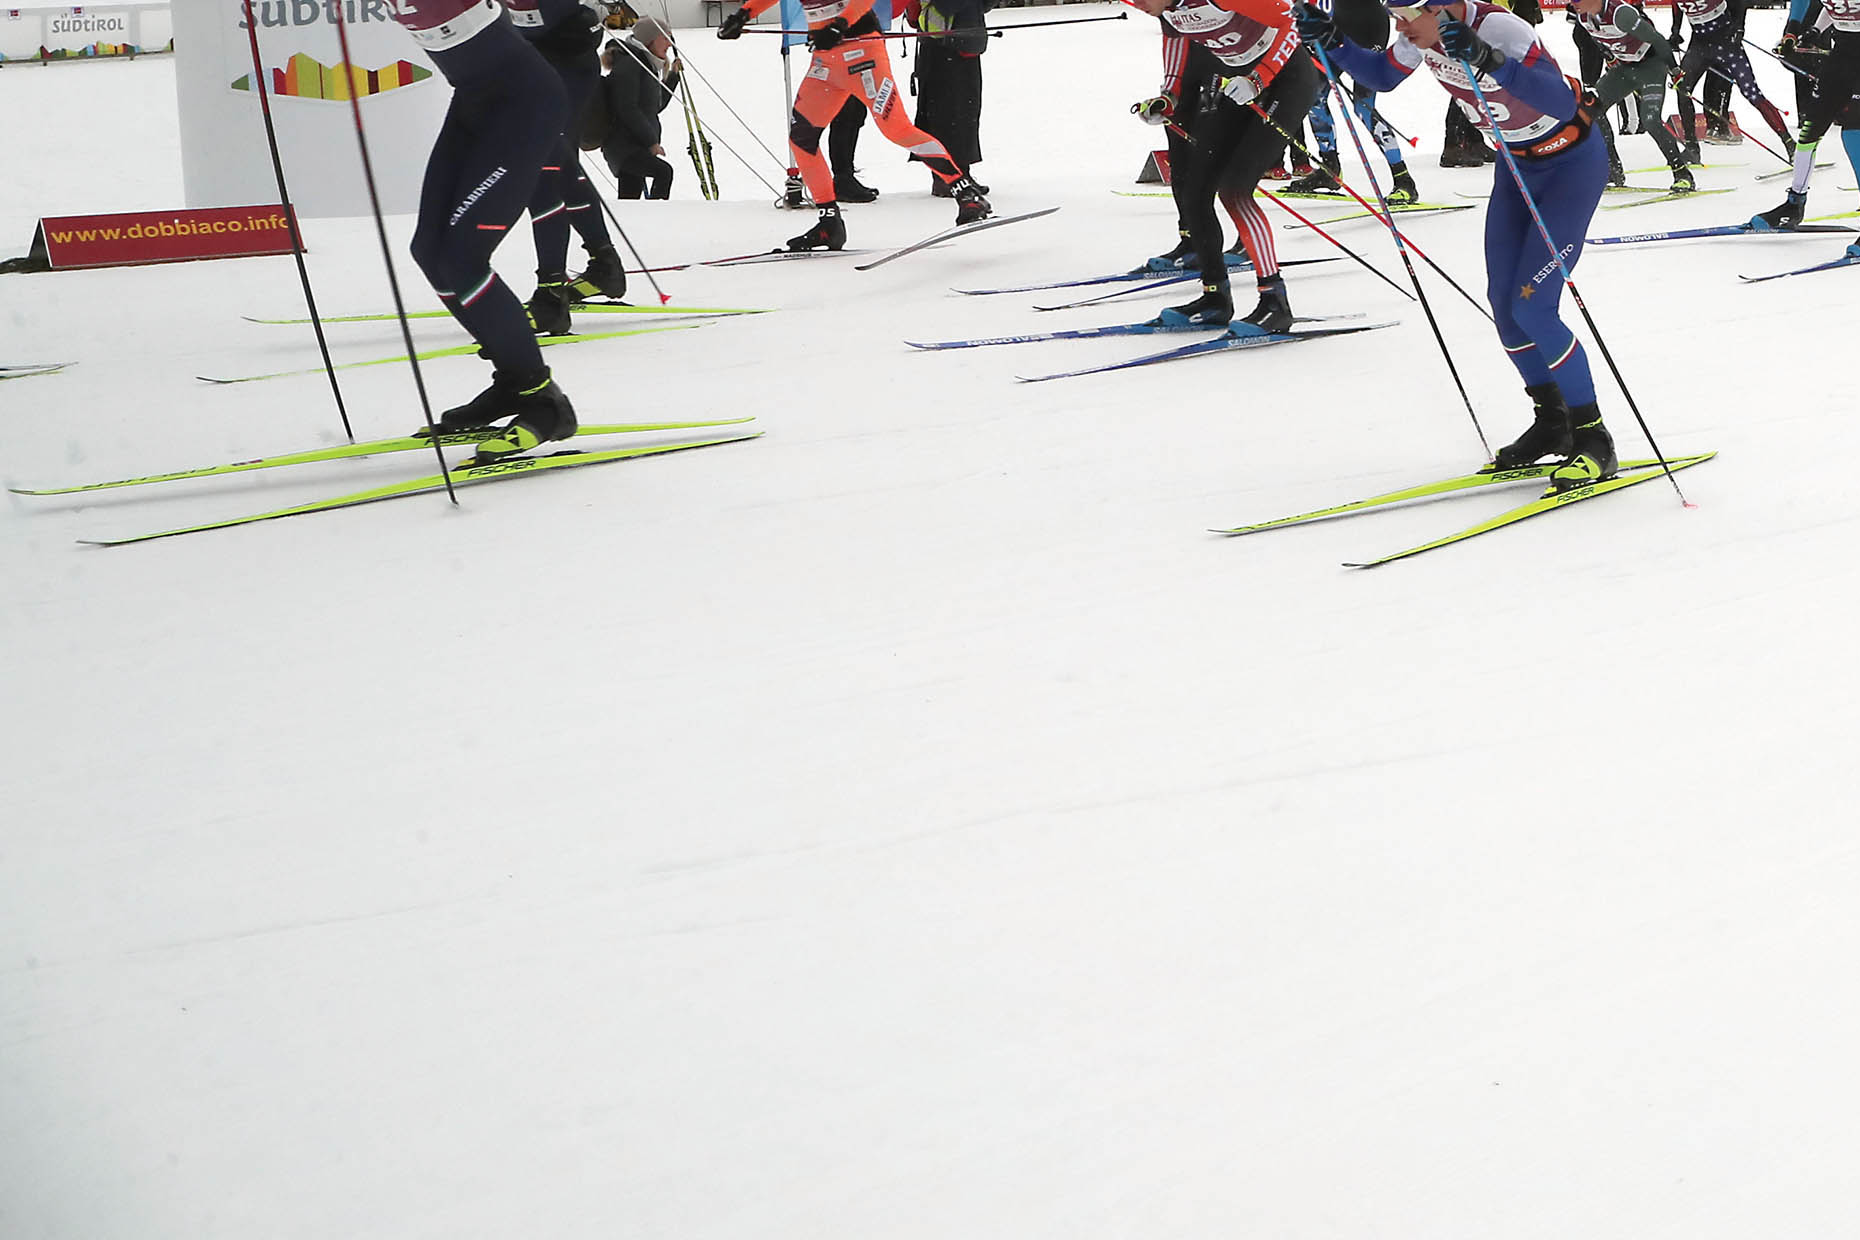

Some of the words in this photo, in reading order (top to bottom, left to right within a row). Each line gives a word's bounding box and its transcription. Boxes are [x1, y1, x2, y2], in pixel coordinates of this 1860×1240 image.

[450, 166, 508, 226] CARABINIERI
[51, 214, 289, 244] www.dobbiaco.info
[1227, 335, 1271, 348] SALOMON
[466, 460, 537, 478] FISCHER
[1490, 468, 1543, 481] FISCHER
[1557, 486, 1594, 504] FISCHER
